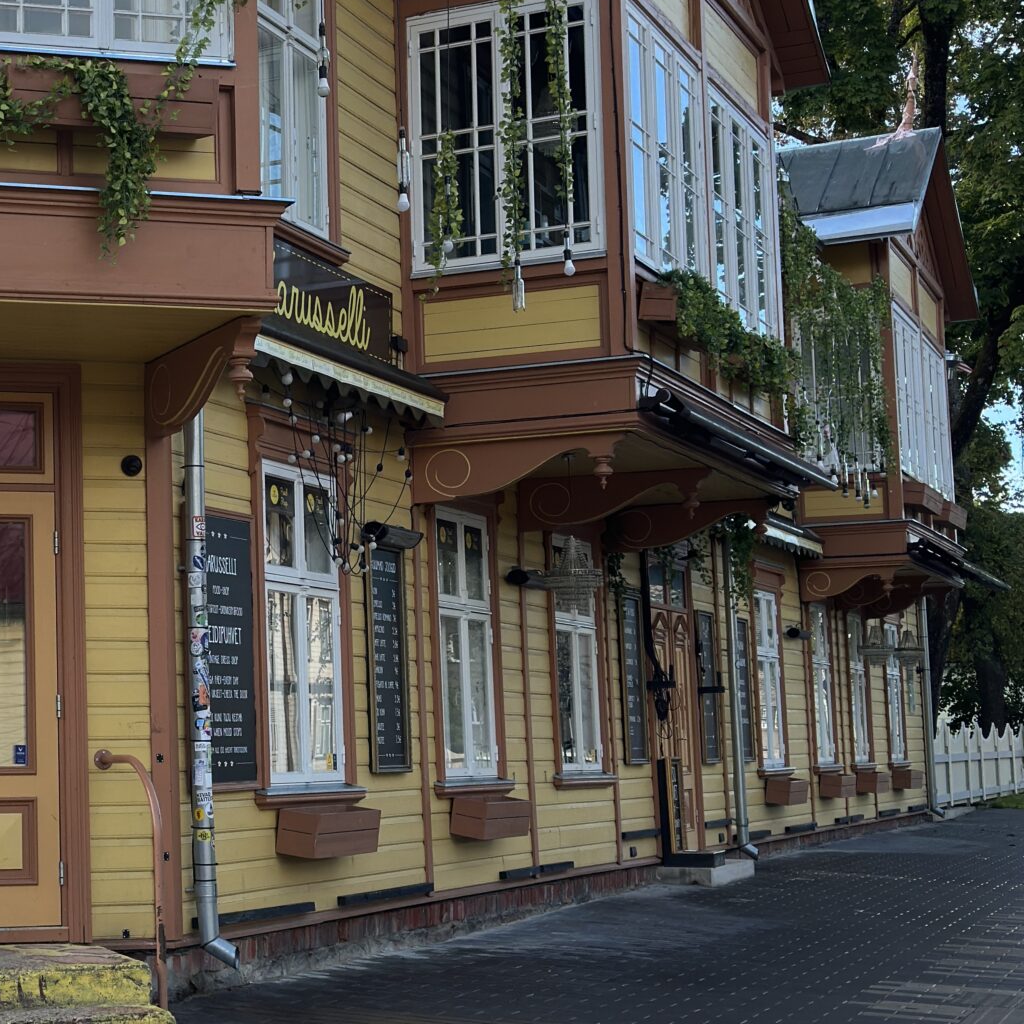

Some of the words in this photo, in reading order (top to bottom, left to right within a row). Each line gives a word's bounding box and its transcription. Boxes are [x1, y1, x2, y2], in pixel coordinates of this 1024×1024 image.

[273, 280, 370, 351] arusselli
[205, 554, 237, 576] ARUSSELLI
[208, 625, 242, 645] EIDIPUHVET
